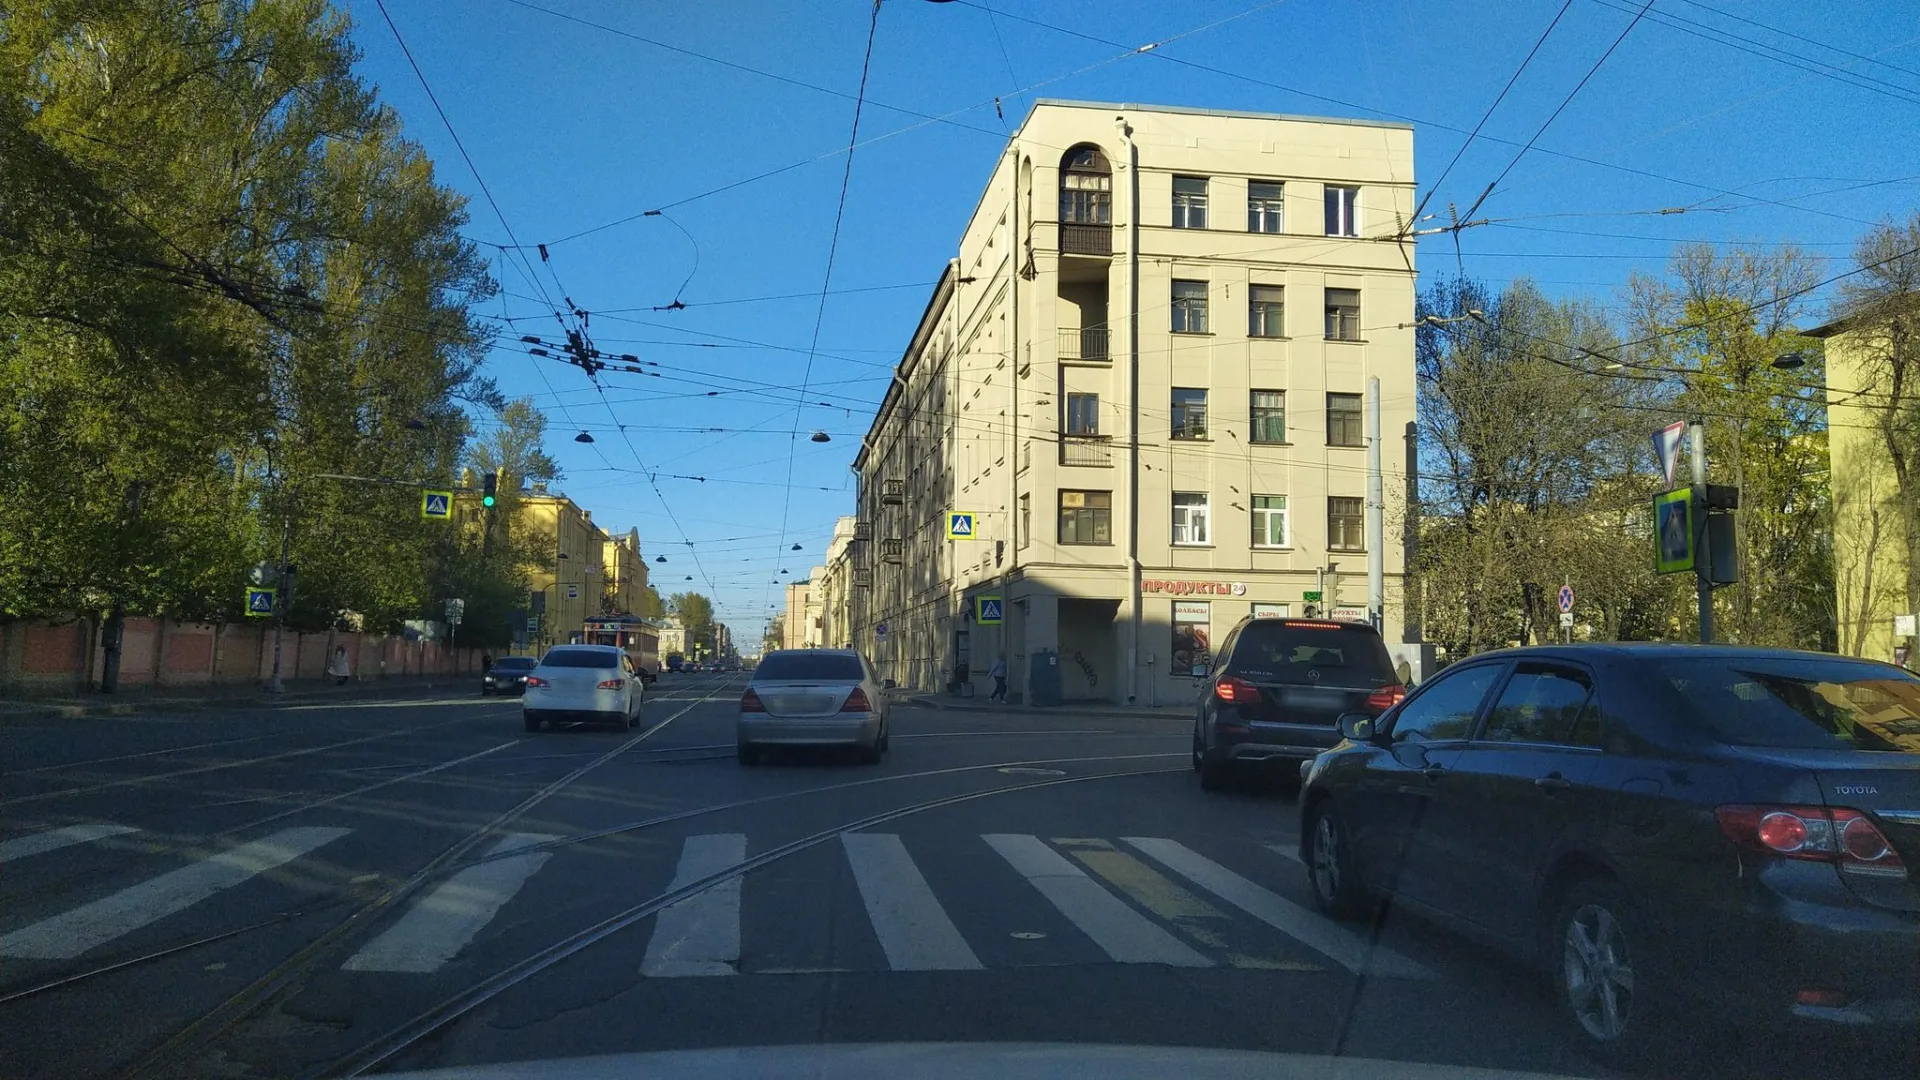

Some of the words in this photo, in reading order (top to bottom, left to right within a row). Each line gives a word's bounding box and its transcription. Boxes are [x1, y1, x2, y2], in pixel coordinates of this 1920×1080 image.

[1142, 580, 1231, 595] ПРОДУКТЫ
[1233, 584, 1244, 592] 24
[1834, 786, 1878, 795] TOYOTA
